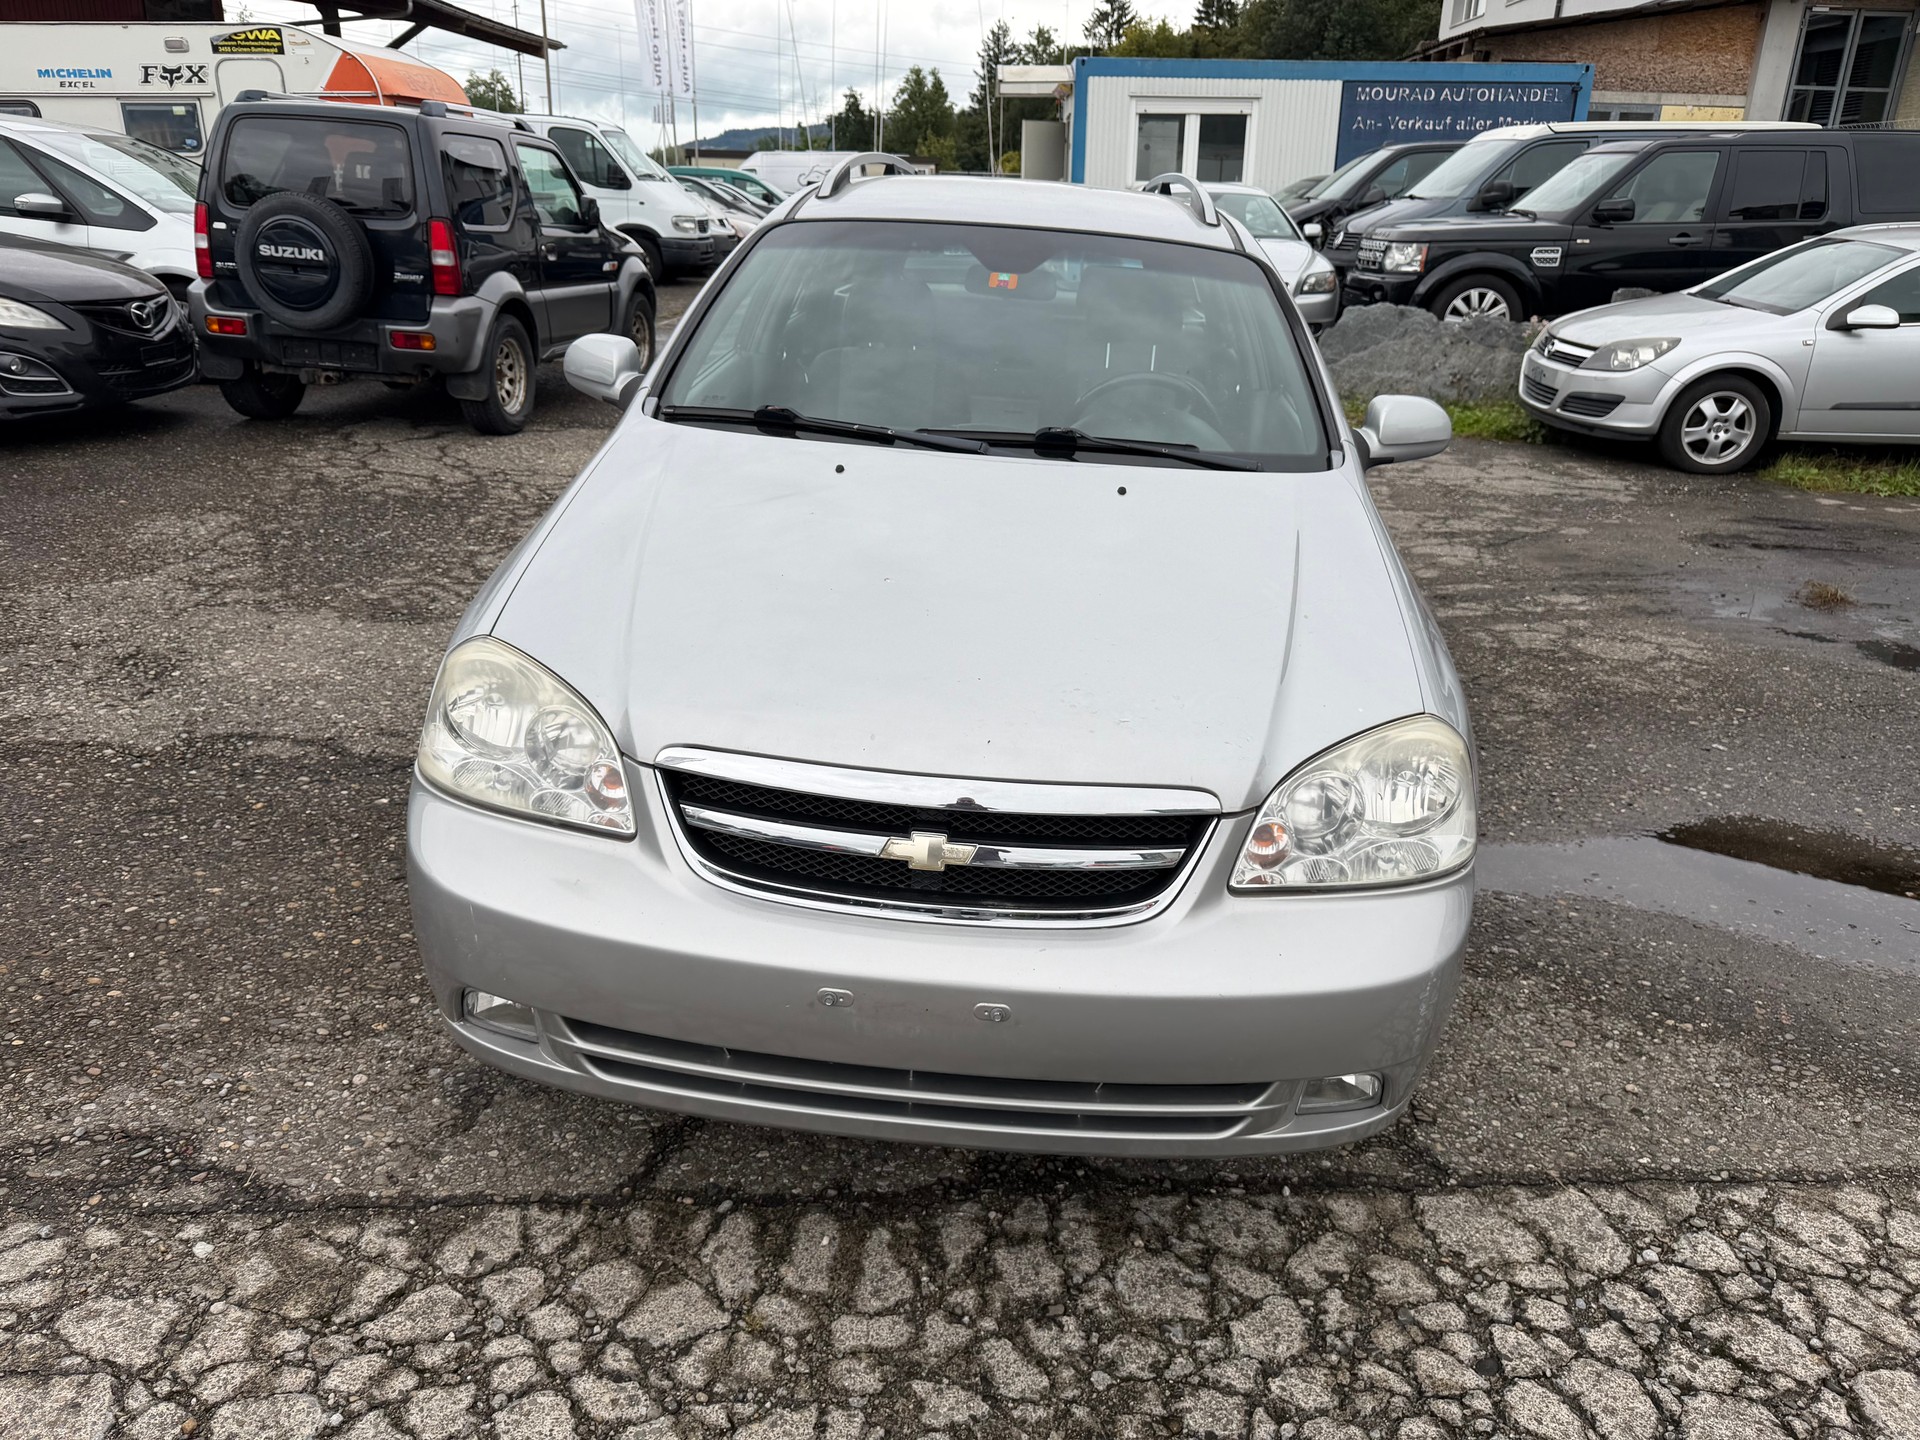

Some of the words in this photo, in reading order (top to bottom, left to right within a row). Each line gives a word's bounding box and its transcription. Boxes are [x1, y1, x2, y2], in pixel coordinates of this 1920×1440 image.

[37, 68, 113, 79] MICHELIN
[59, 80, 96, 89] EXCEL
[1356, 86, 1436, 102] MOURAD
[1440, 87, 1564, 103] AUTOHANDEL
[1352, 115, 1383, 131] An-
[1388, 115, 1452, 131] Verkauf
[1456, 116, 1493, 131] aller
[258, 243, 324, 261] SUZUKI
